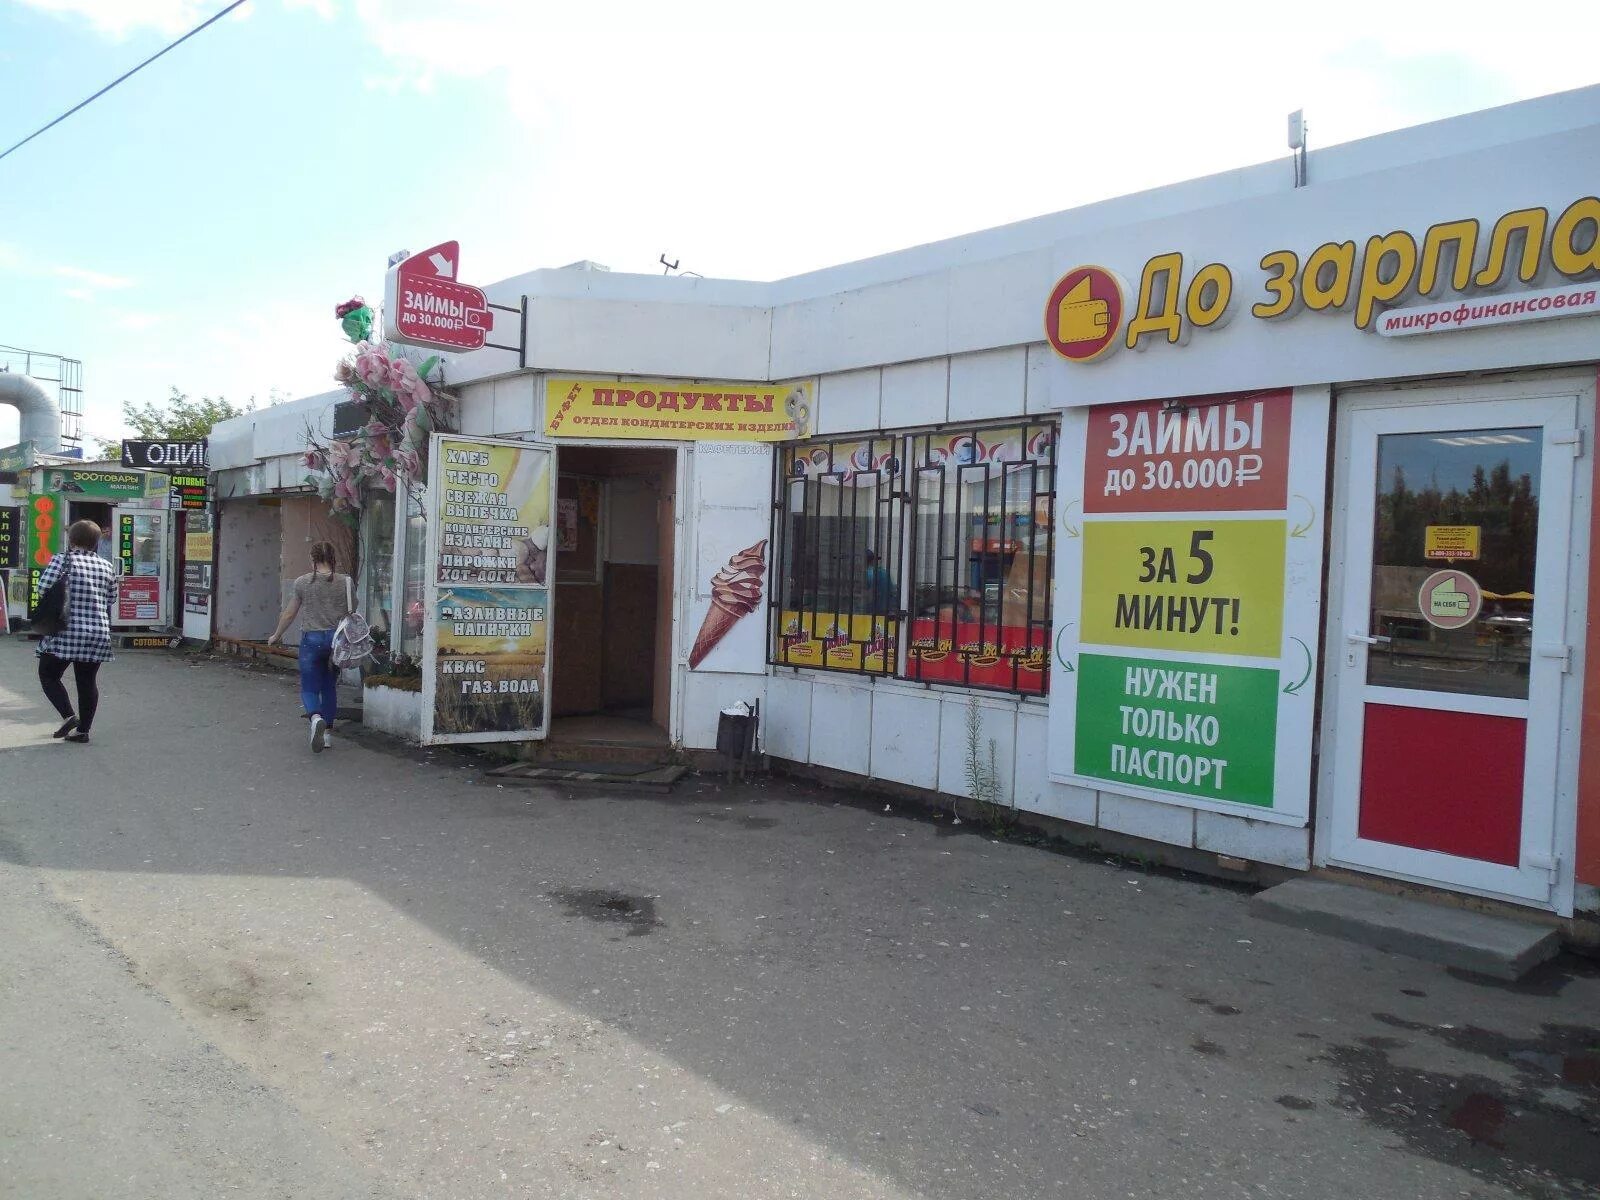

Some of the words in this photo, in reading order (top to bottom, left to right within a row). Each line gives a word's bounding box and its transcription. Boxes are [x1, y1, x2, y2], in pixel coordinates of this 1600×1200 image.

[404, 291, 464, 318] ЗАЙМЫ
[1127, 252, 1233, 349] До
[1385, 290, 1596, 331] микрофинансовая
[402, 312, 417, 323] до
[549, 383, 582, 431] БУФЕТ
[592, 388, 775, 413] ПРОДУКТЫ
[573, 415, 619, 427] ОТДЕЛ
[621, 417, 734, 431] КОНДИТЕРСКИХ
[1106, 402, 1264, 458] ЗАЙМЫ
[447, 449, 489, 466] ХЛЕБ
[698, 444, 771, 456] КАФЕТЕРИЙ
[74, 471, 139, 484] ЗООТОВАРЫ
[172, 476, 206, 487] СОТОВЫЕ
[446, 470, 499, 487] ТЕСТО
[1104, 468, 1136, 497] до
[446, 489, 508, 506] СВЕЖАЯ
[446, 504, 518, 521] ВЫПЕЧКА
[0, 511, 10, 565] КЛЮЧИ
[122, 517, 132, 573] СОТОВЫЕ
[445, 534, 513, 549] ИЗДЕЛИЯ
[442, 554, 517, 569] ПИРОЖКИ
[1139, 547, 1176, 583] ЗА
[1186, 530, 1214, 584] 5
[441, 568, 516, 582] ХОТ-ДОГИ
[31, 570, 41, 612] ОПТИК
[1115, 594, 1240, 635] МИНУТ!
[454, 623, 531, 636] НАПИТКИ
[133, 638, 169, 646] СОТОВЫЕ
[443, 660, 486, 674] КВАС
[1125, 667, 1218, 704] НУЖЕН
[1119, 706, 1220, 746] ТОЛЬКО
[1111, 744, 1227, 789] ПАСПОРТ
